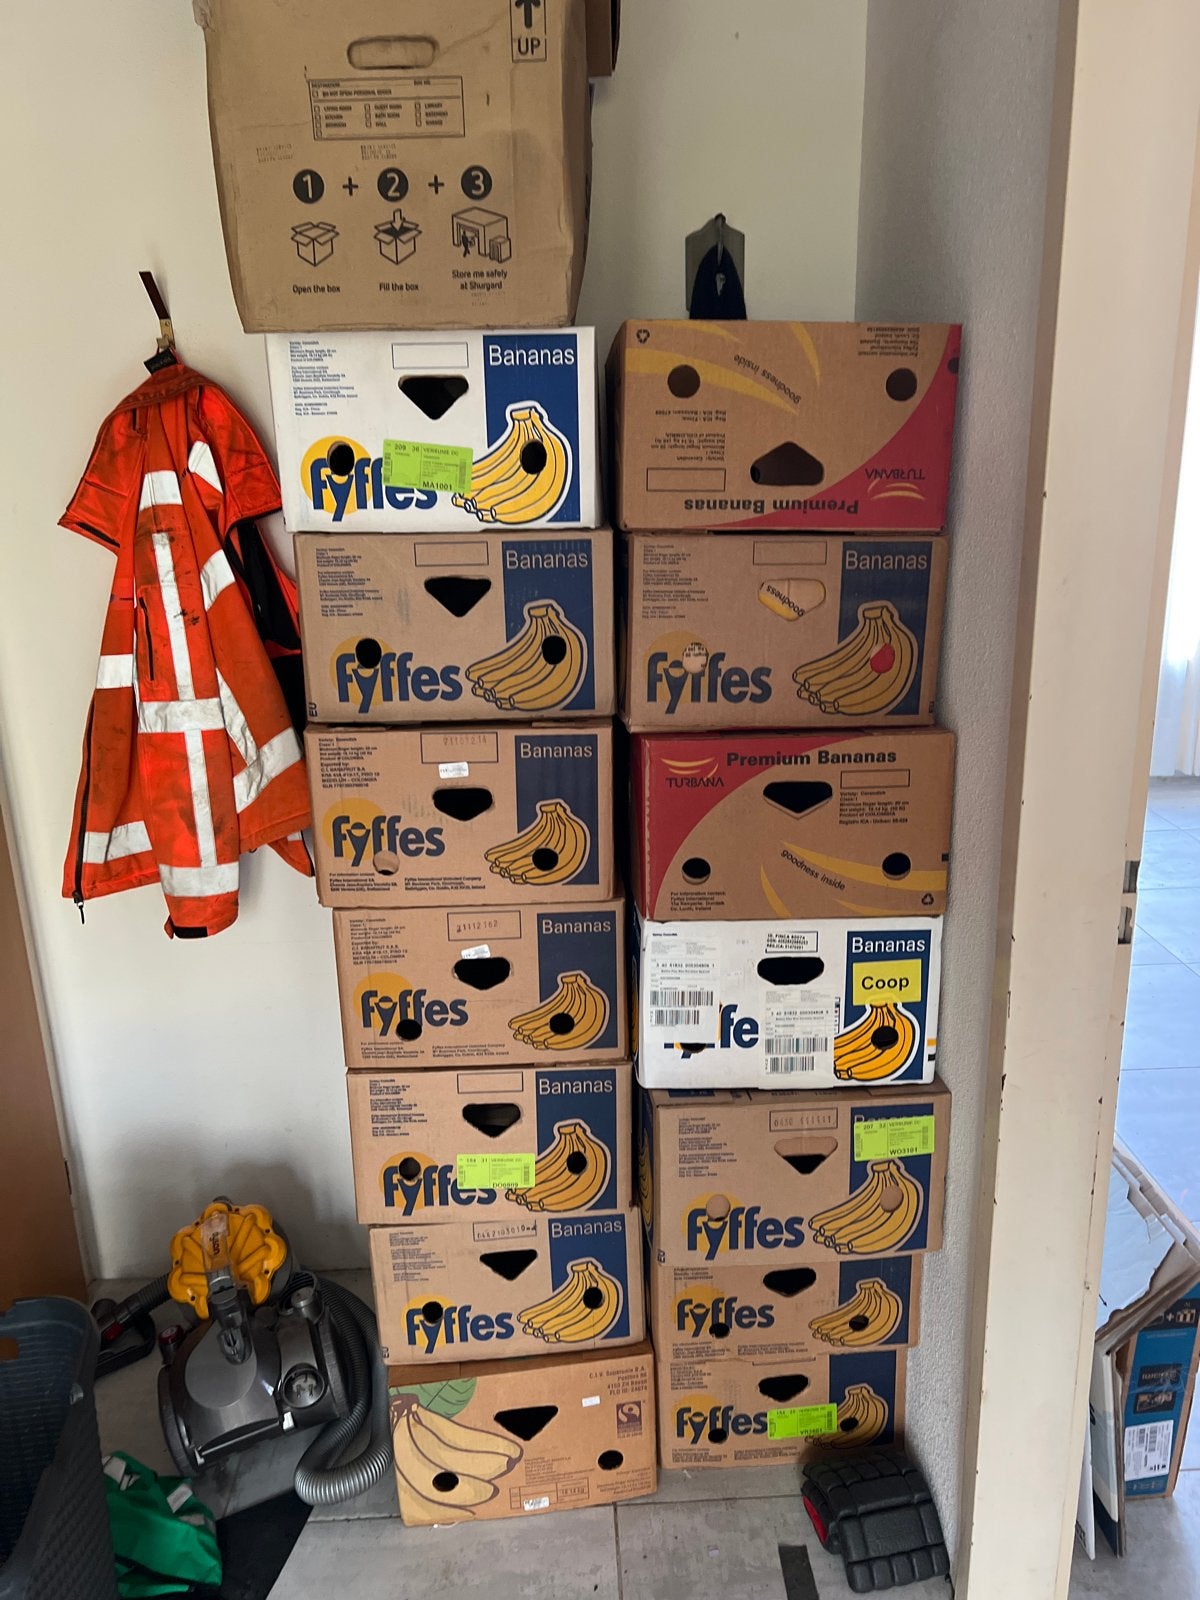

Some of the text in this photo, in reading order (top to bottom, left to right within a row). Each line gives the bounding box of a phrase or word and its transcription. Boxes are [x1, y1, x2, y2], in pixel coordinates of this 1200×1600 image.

[517, 37, 541, 55] UP
[302, 175, 313, 199] 1
[386, 174, 401, 197] 2
[471, 172, 485, 195] 3
[452, 270, 471, 279] Store
[486, 269, 507, 279] safely
[293, 285, 340, 295] Open the box
[379, 283, 419, 291] Fill the box
[469, 282, 502, 292] Shurgard
[489, 345, 575, 366] Bananas
[733, 354, 802, 404] goodness inside
[865, 468, 926, 480] TURBANA
[423, 481, 452, 490] MA1001
[684, 498, 859, 515] Premium Bananas
[506, 550, 589, 569] Bananas
[845, 551, 928, 570] Bananas
[766, 584, 805, 618] goodness
[336, 652, 463, 713] fyffes
[647, 652, 772, 715] fyffes
[308, 702, 317, 717] EU
[520, 743, 593, 759] Bananas
[726, 750, 897, 767] Premium Bananas
[666, 776, 725, 788] TURBANA
[332, 815, 445, 867] fyffes
[780, 849, 846, 891] goodness inside
[542, 919, 611, 934] Bananas
[852, 937, 926, 954] Bananas
[861, 976, 910, 992] Coop
[361, 989, 469, 1036] fyffes
[539, 1078, 613, 1095] Bananas
[890, 1147, 918, 1155] WO3101
[551, 1220, 622, 1238] Bananas
[687, 1206, 804, 1261] fyffes
[677, 1297, 775, 1337] fyffes
[406, 1305, 515, 1354] fyffes
[676, 1405, 769, 1444] fyffes
